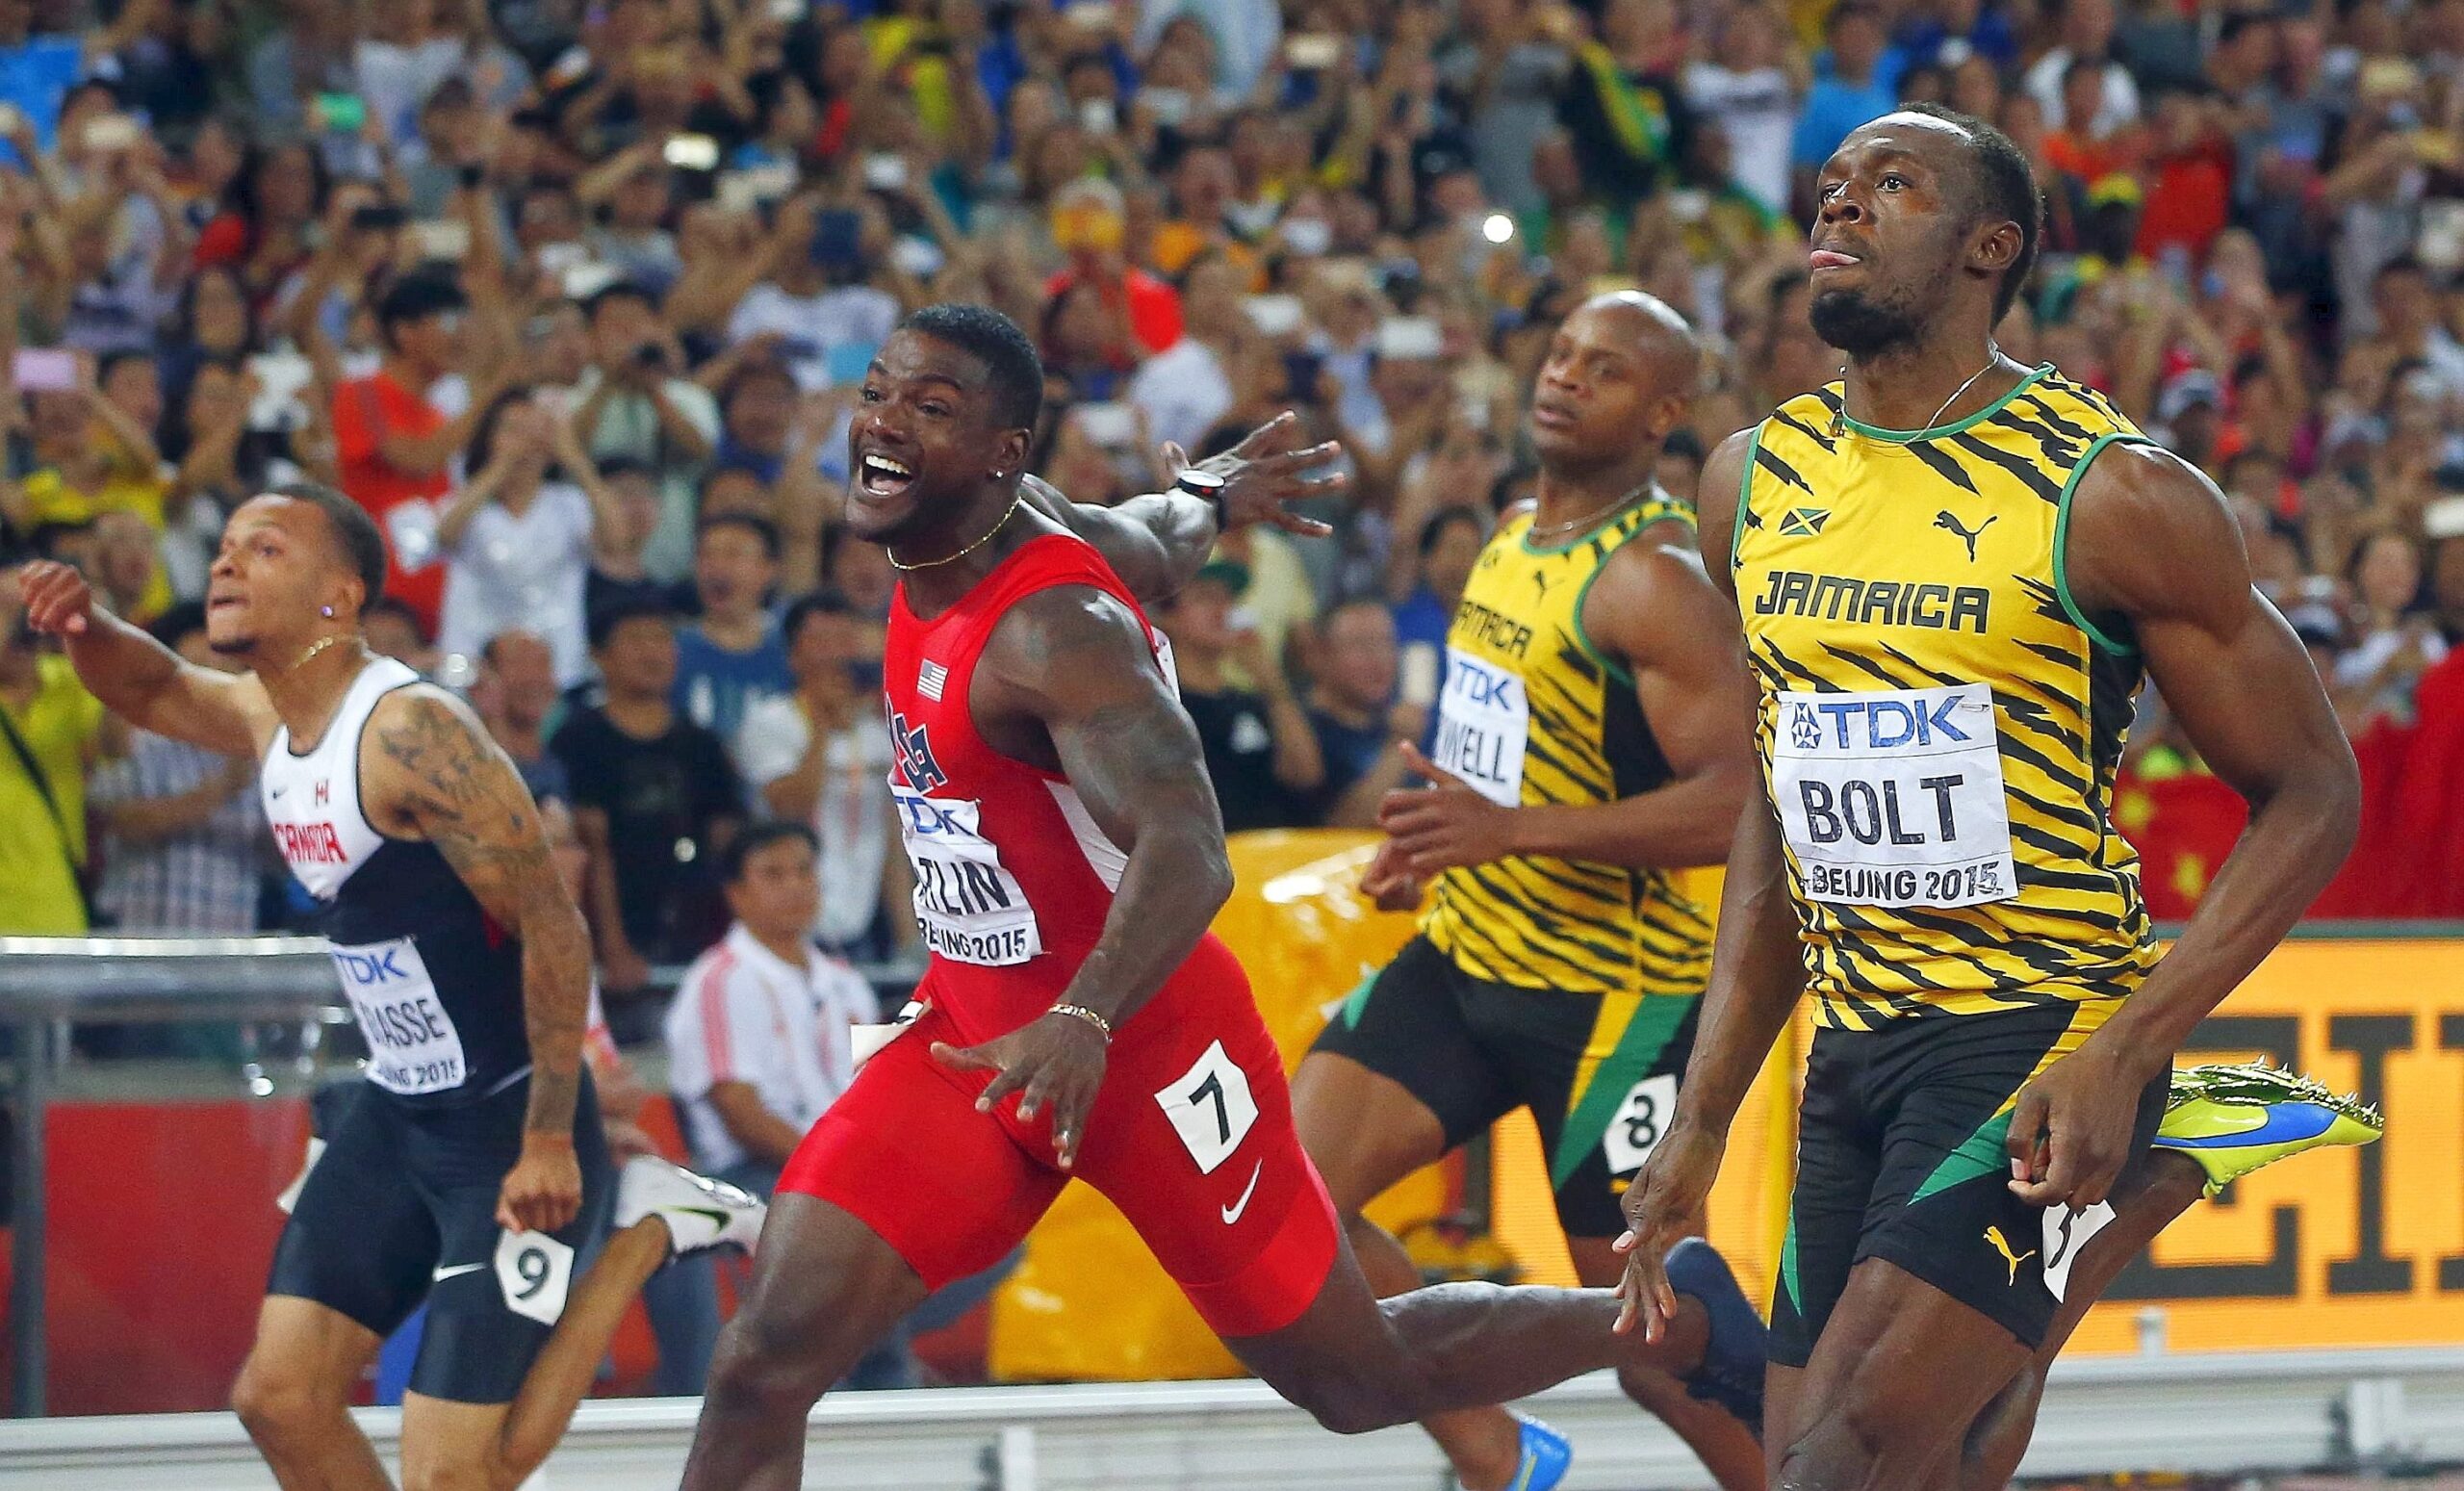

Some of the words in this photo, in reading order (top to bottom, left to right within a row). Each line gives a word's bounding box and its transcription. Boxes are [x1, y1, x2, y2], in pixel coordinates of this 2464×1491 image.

[1754, 570, 1990, 635] JAMAICA
[1457, 659, 1511, 711] TDK
[1818, 695, 1973, 751] TDK
[1799, 774, 1964, 846] BOLT
[273, 822, 347, 863] CANADA
[1812, 864, 1917, 901] BEIJING
[1924, 861, 2000, 902] 2015
[971, 928, 1027, 961] 2015
[1188, 1069, 1231, 1145] 7
[1624, 1094, 1656, 1149] 8
[515, 1247, 550, 1299] 9
